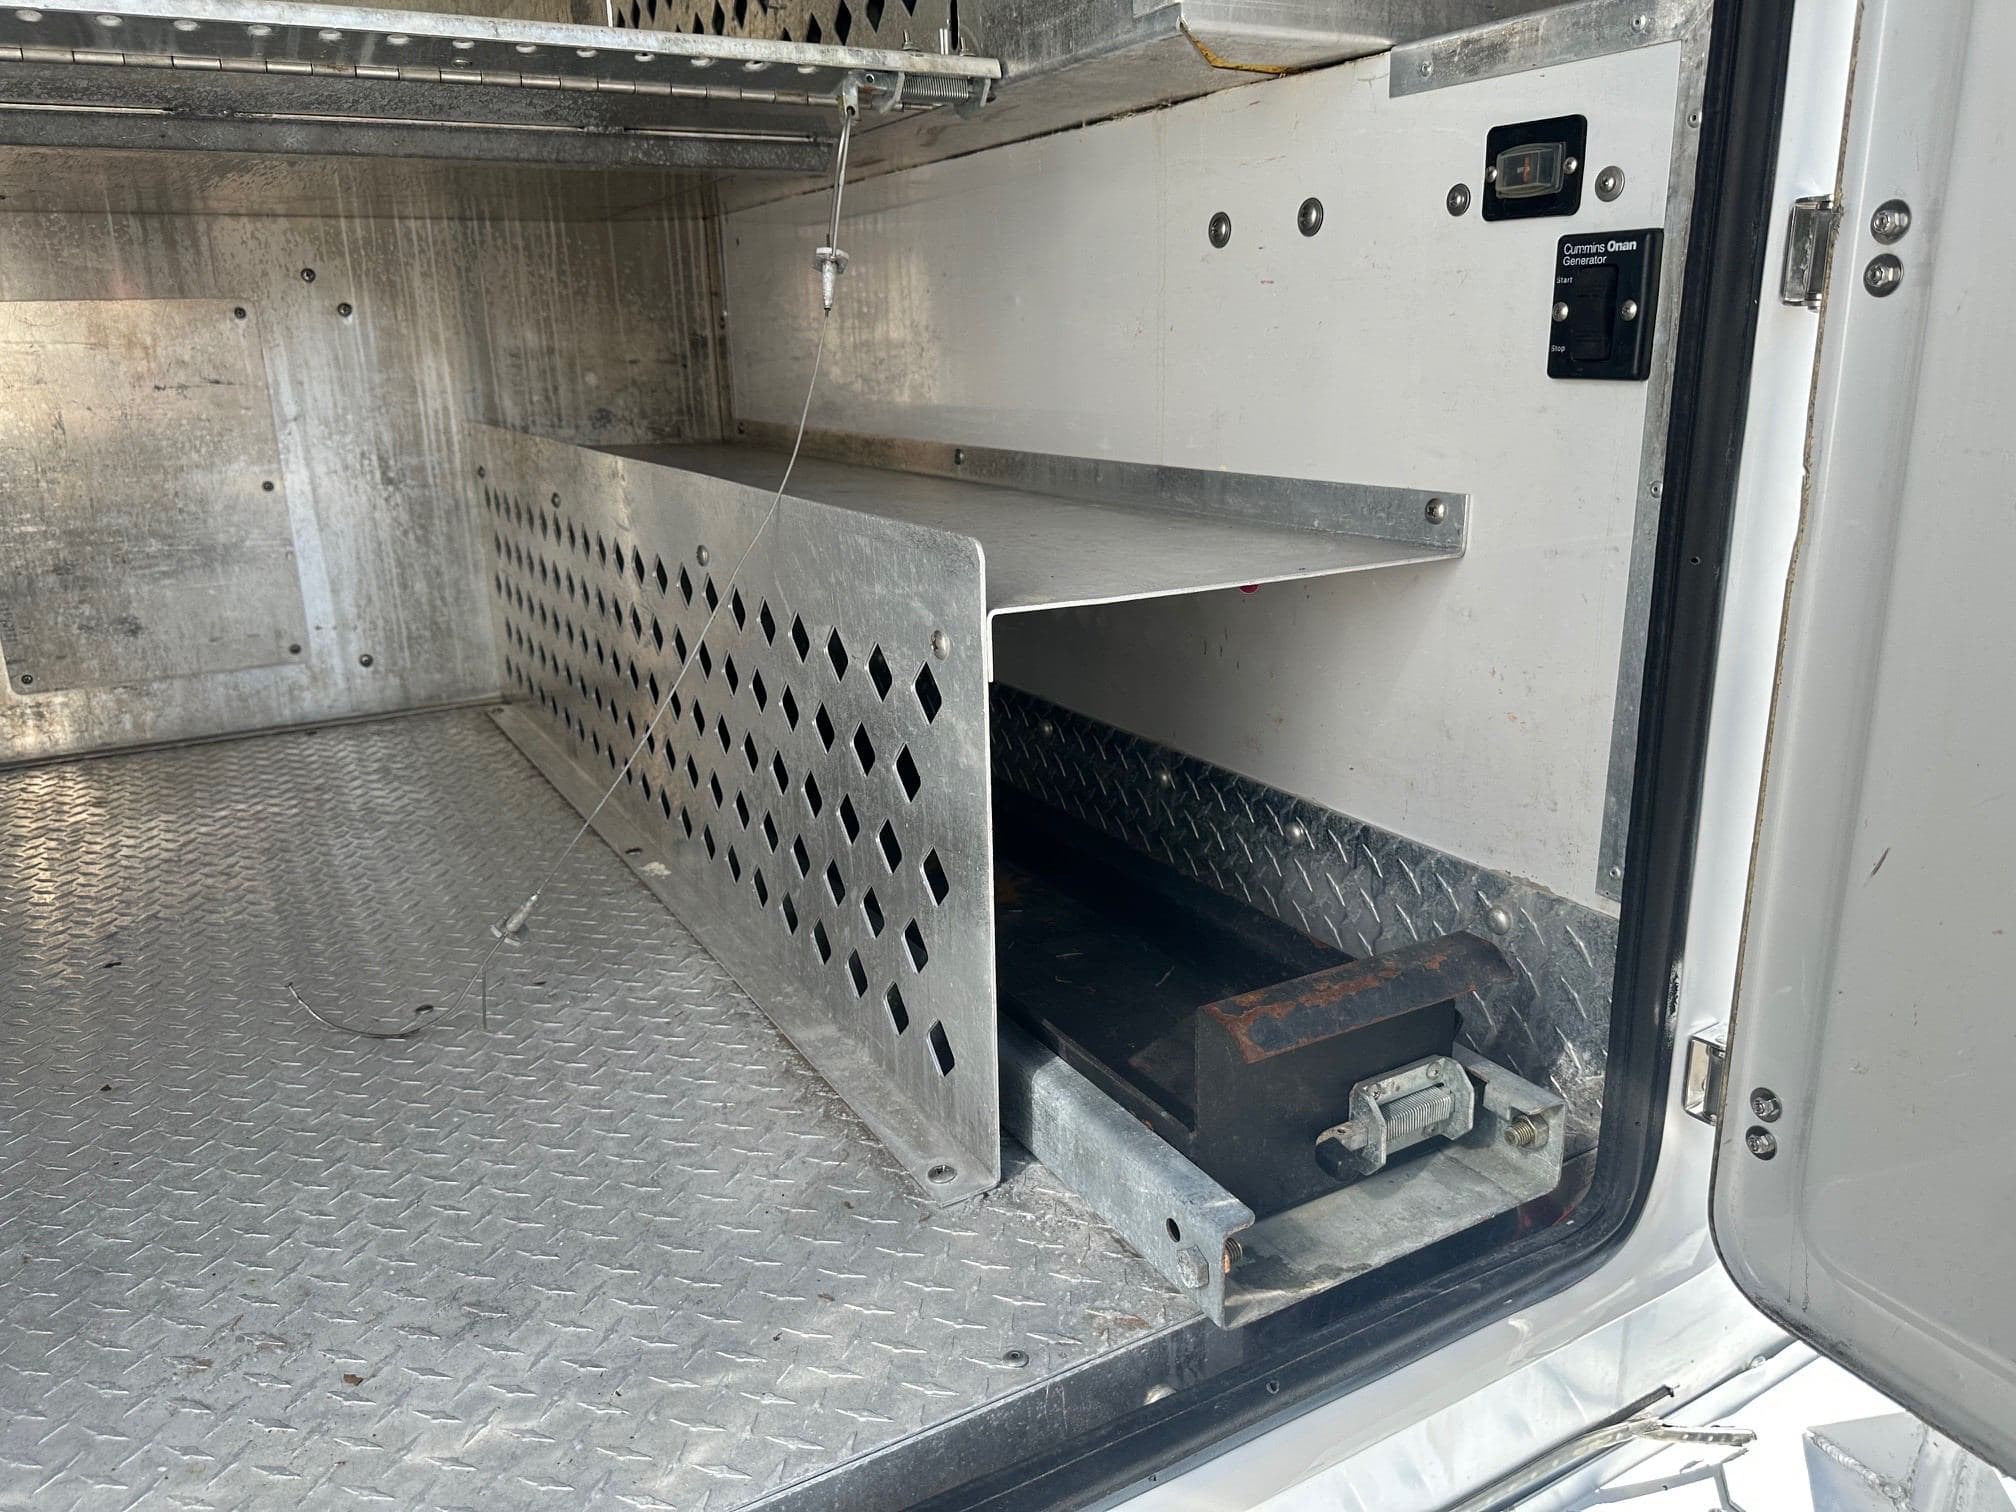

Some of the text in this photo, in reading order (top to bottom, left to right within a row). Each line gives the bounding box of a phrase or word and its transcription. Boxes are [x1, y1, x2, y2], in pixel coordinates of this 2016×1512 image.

[1563, 240, 1637, 255] Cummins Onan
[1563, 255, 1607, 266] Generator
[1556, 276, 1573, 284] Start
[1551, 345, 1566, 353] Stop
